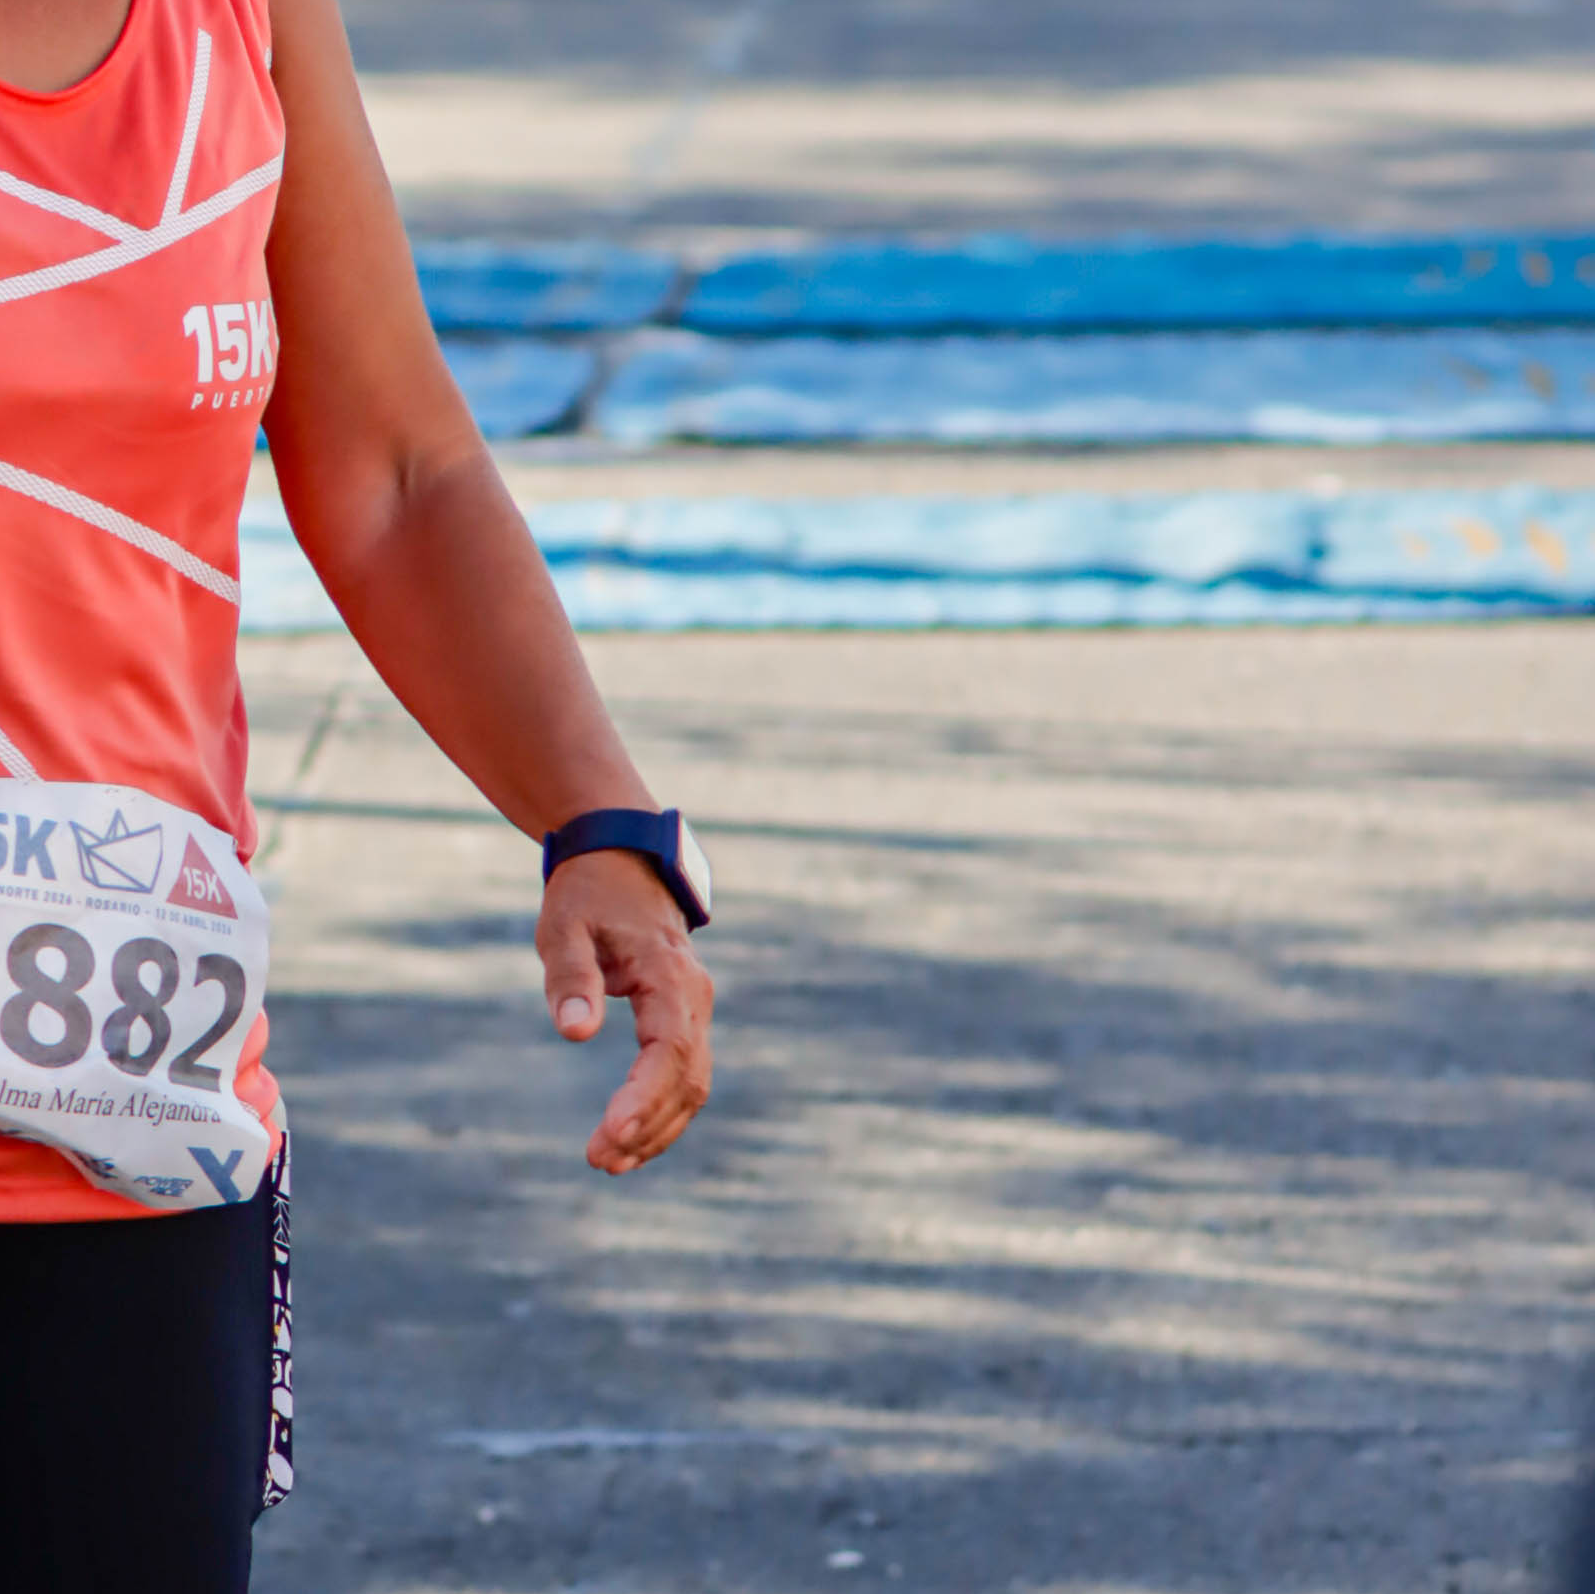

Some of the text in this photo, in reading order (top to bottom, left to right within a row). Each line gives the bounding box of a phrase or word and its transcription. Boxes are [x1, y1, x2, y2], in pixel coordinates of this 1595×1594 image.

[183, 300, 273, 383] 15K
[183, 865, 223, 904] 15K
[85, 896, 141, 916] ROSARIO
[48, 1087, 114, 1116] María
